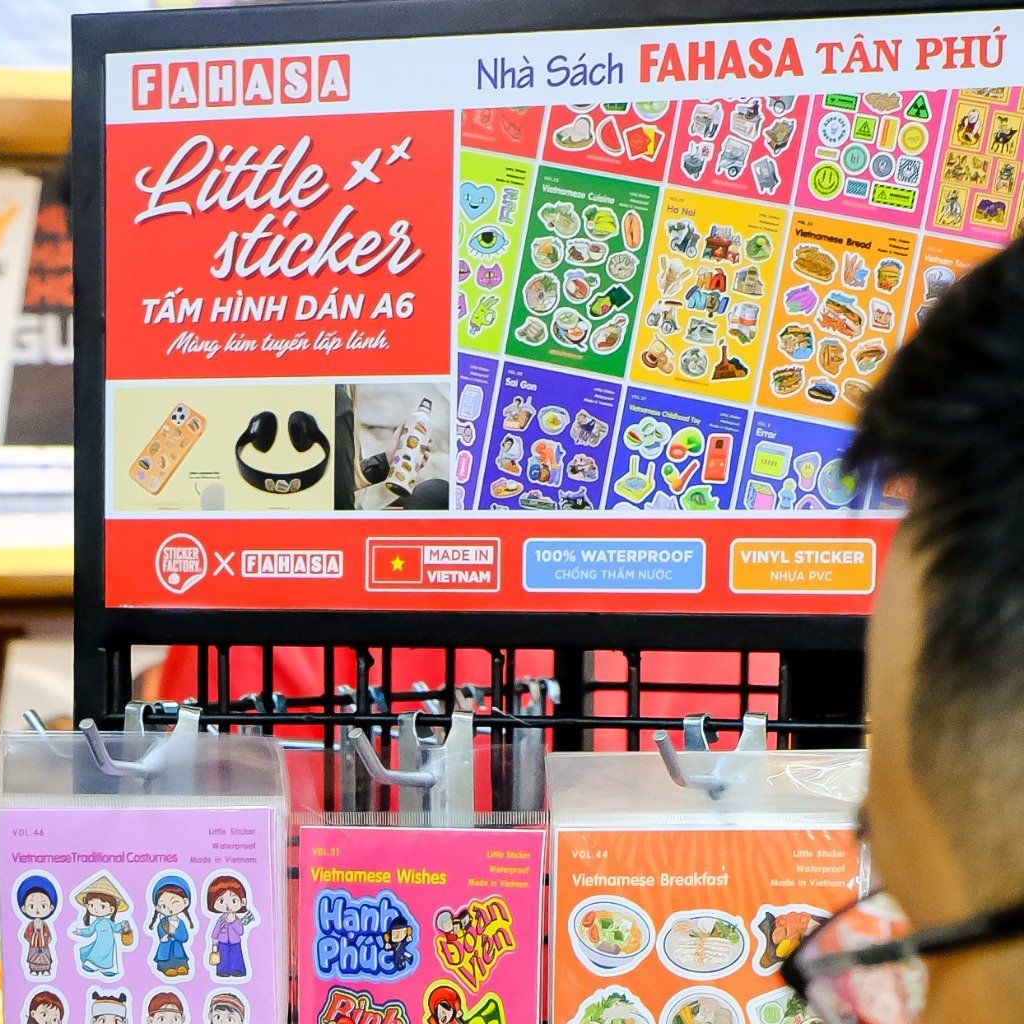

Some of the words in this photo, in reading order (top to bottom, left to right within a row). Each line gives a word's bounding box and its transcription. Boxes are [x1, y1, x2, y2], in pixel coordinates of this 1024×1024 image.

[477, 56, 535, 89] Nhà
[546, 52, 623, 89] Sách
[639, 37, 805, 84] FAHASA
[815, 33, 902, 75] TÂN
[916, 26, 1008, 71] PHÚ
[134, 56, 349, 108] FAHASA
[134, 135, 329, 224] Little
[210, 204, 424, 280] sticker
[142, 287, 204, 324] TẤM
[210, 290, 288, 322] HÌNH
[295, 287, 364, 320] DÁN
[371, 292, 415, 319] A6
[756, 428, 777, 439] Error
[429, 549, 471, 561] MADE
[475, 549, 489, 561] IN
[534, 549, 576, 563] 100%
[581, 549, 694, 563] WATERPROOF
[740, 550, 790, 564] VINYL
[794, 551, 864, 564] STICKER
[244, 552, 341, 576] FAHASA
[427, 570, 491, 584] VIETNAM
[555, 565, 598, 580] CHỐNG
[601, 566, 635, 580] THẤM
[770, 570, 805, 584] NHỰA
[808, 571, 833, 582] PVC
[208, 828, 227, 836] Little
[230, 828, 256, 836] Sticker
[211, 841, 257, 852] Waterproof
[126, 852, 178, 864] Costumes
[190, 856, 211, 864] Made
[225, 856, 257, 864] Vietnam
[311, 867, 391, 884] Vietnamese
[397, 868, 447, 885] Wishes
[572, 873, 655, 887] Vietnamese
[660, 871, 729, 887] Breakfast
